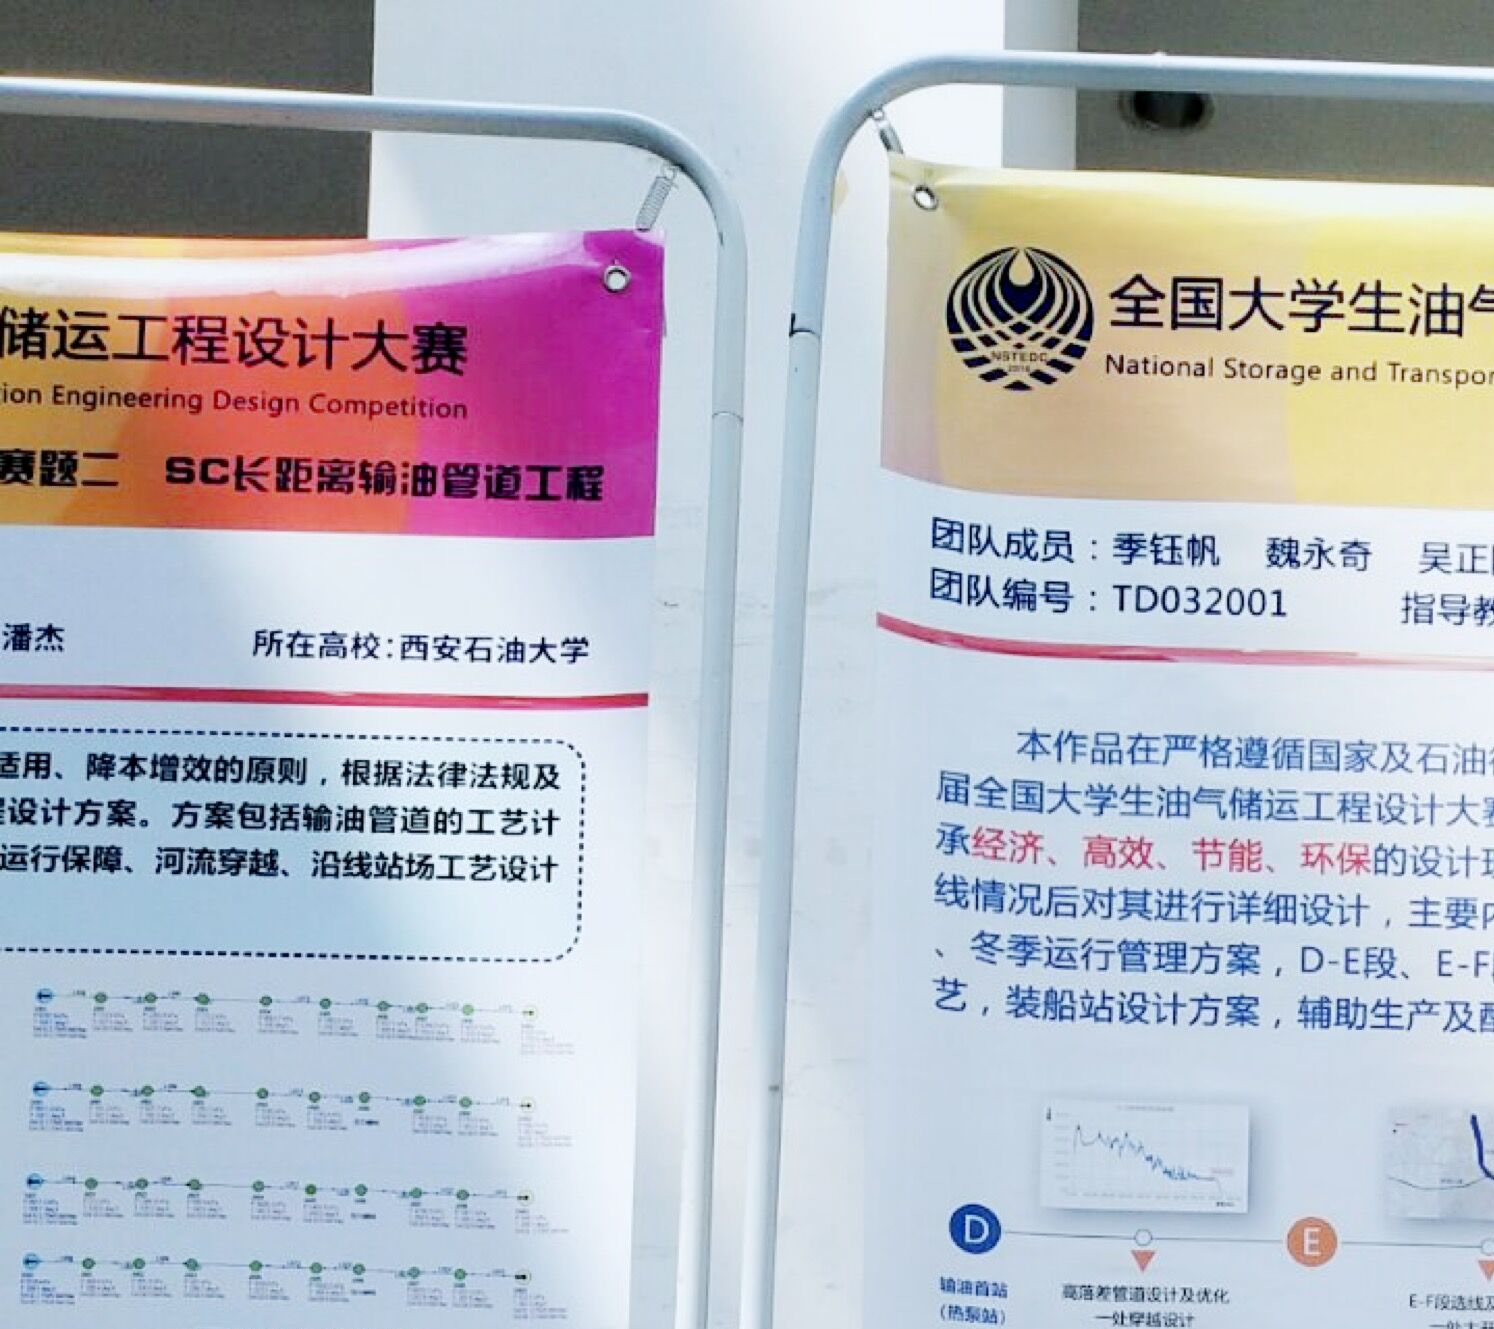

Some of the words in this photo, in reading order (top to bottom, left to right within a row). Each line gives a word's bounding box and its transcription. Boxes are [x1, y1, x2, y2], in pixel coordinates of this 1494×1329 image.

[0, 306, 468, 376] 储运工程设计大赛
[1105, 353, 1214, 379] National
[1224, 358, 1322, 386] Storage
[1331, 359, 1377, 383] and
[52, 384, 202, 414] Engineering
[212, 390, 300, 417] Design
[309, 392, 468, 420] Competition
[0, 448, 119, 487] 赛题二
[164, 454, 605, 503] SC长距离输油管道工程
[1266, 536, 1373, 573] 魏永奇
[0, 797, 560, 838] 设计方案。方案包括输油管道的工艺计
[964, 1213, 989, 1244] D
[1303, 1227, 1321, 1255] E
